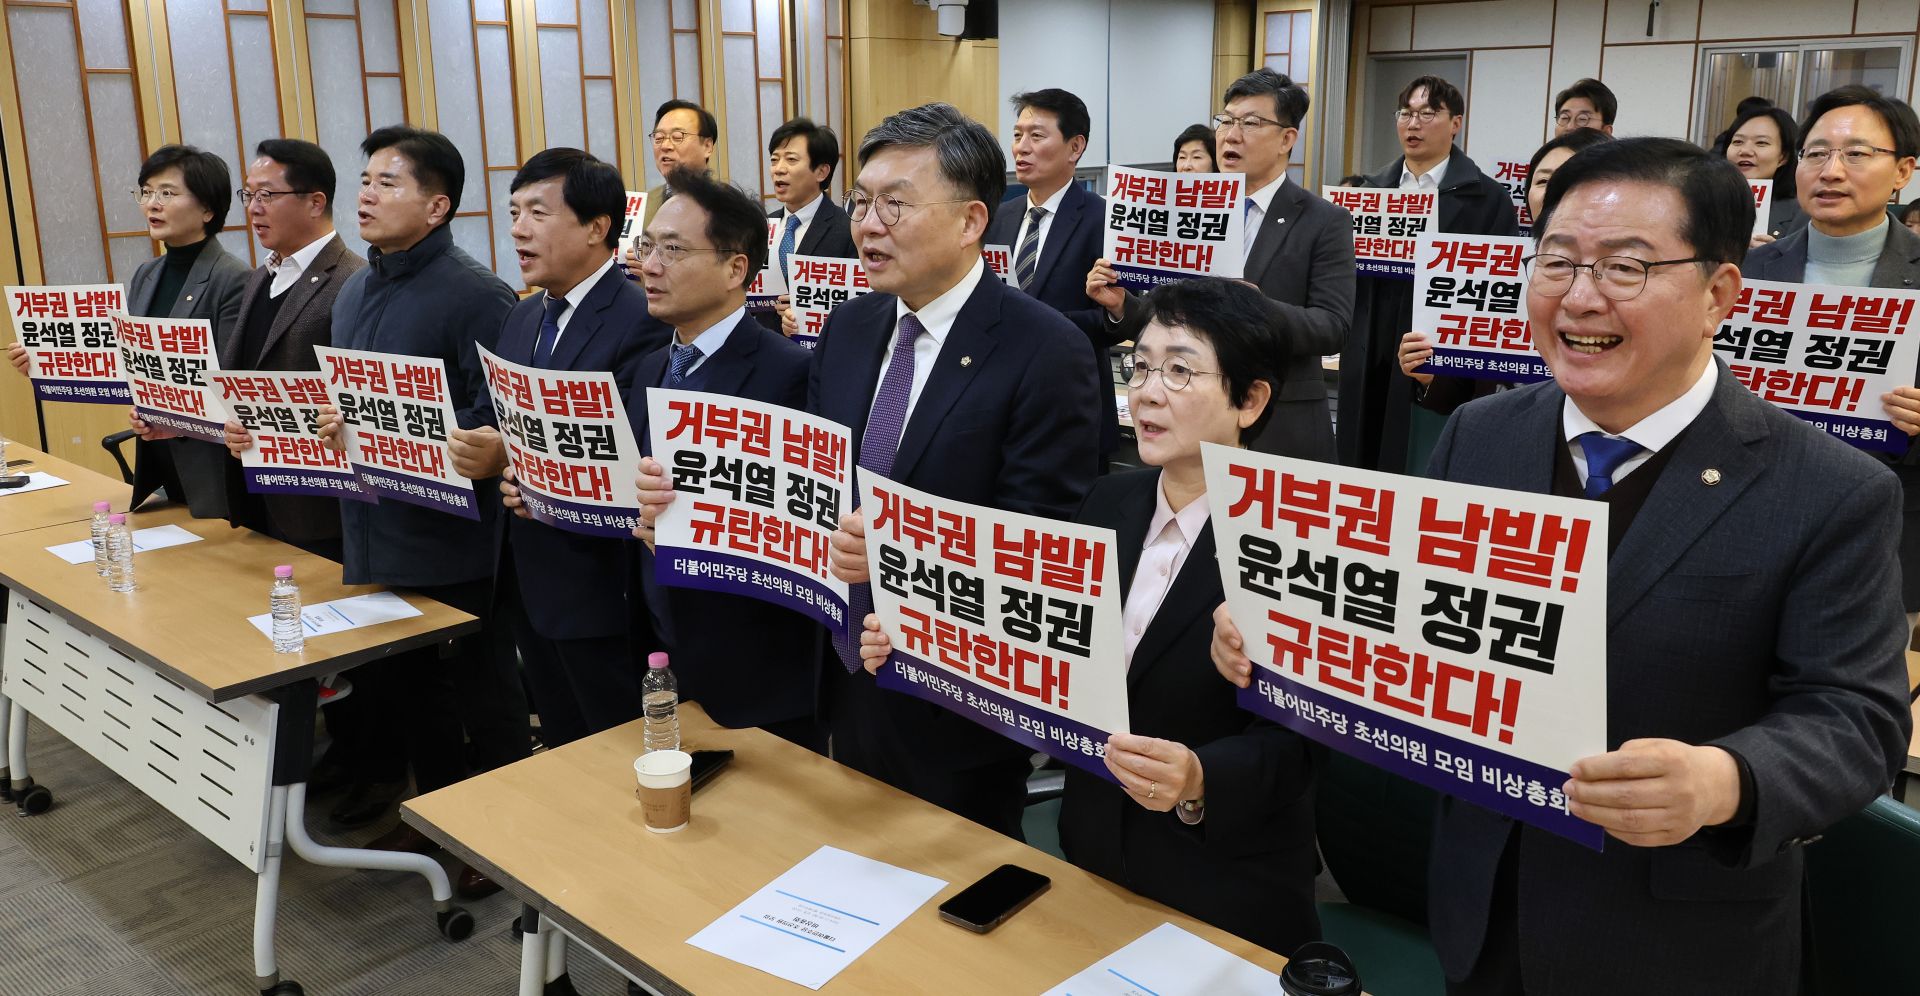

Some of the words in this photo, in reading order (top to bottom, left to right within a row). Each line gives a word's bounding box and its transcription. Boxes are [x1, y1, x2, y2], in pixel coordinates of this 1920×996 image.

[1112, 173, 1167, 205] 거부권
[1175, 180, 1239, 208] 남발!
[1495, 162, 1531, 182] 거부
[1110, 203, 1169, 236] 윤석열
[1177, 212, 1229, 241] 정권
[1329, 191, 1381, 212] 거부권
[1387, 193, 1434, 215] 남발!
[1352, 215, 1382, 235] 석열
[1388, 217, 1427, 237] 정권
[1115, 236, 1213, 272] 규탄한다!
[1354, 237, 1416, 260] 탄한다!
[1426, 241, 1524, 277] 거부권
[794, 260, 847, 286] 거부권
[1366, 263, 1390, 273] 초선의원
[1391, 265, 1403, 274] 모임
[15, 291, 69, 318] 거부권
[73, 290, 122, 317] 남발!
[1425, 276, 1522, 313] 윤석열
[1806, 294, 1916, 335] 남발!
[22, 322, 77, 347] 윤석열
[112, 315, 154, 350] 거부권
[157, 324, 208, 355] 남발!
[1712, 324, 1794, 364] 석열
[1804, 334, 1895, 375] 정권
[37, 351, 117, 378] 규탄한다!
[121, 346, 166, 381] 윤석열
[166, 357, 208, 386] 정권
[326, 355, 389, 394] 거부권
[391, 362, 444, 403] 남발!
[1487, 360, 1529, 375] 초선의원
[39, 384, 73, 395] 더불어민주당
[74, 386, 98, 397] 초선의원
[98, 387, 111, 398] 모임
[111, 388, 132, 398] 비상총
[134, 378, 207, 417] 규탄한다!
[213, 376, 284, 403] 거부권
[483, 355, 536, 412] 거부권
[538, 378, 615, 419] 남발!
[1729, 364, 1866, 412] 탄한다!
[233, 404, 301, 434] 윤석열
[337, 392, 401, 434] 윤석열
[401, 402, 448, 442] 정권
[494, 396, 549, 454] 윤석열
[552, 421, 619, 462] 정권
[1832, 424, 1888, 442] 비상총회
[357, 430, 446, 479] 규탄한다!
[666, 400, 772, 458] 거부권
[782, 418, 847, 484] 남발!
[255, 473, 299, 487] 더불어민주당
[300, 475, 329, 489] 초선의원
[328, 478, 343, 490] 모임
[361, 472, 399, 491] 더불어민주당
[400, 481, 427, 498] 초선의원
[426, 485, 441, 502] 모임
[440, 490, 469, 509] 비상총회
[509, 442, 613, 502] 규탄한다!
[671, 449, 776, 510] 윤석열
[786, 471, 841, 532] 정권
[546, 504, 581, 523] 초선의원
[581, 512, 603, 527] 모임
[1227, 463, 1396, 557] 거부권
[1417, 496, 1592, 594] 남발!
[690, 501, 830, 580] 규탄한다!
[872, 485, 977, 568] 거부권
[992, 522, 1107, 598] 남발!
[674, 557, 748, 584] 더불어민주당
[751, 570, 793, 597] 초선의원
[795, 583, 814, 606] 모임
[815, 592, 844, 627] 비상총회
[878, 543, 986, 627] 윤석열
[999, 584, 1095, 659] 정권
[1237, 533, 1400, 634] 윤석열
[1420, 577, 1565, 676] 정권
[899, 604, 1071, 711] 규탄한다!
[1266, 608, 1522, 746] 규탄한다!
[894, 661, 963, 703] 더불어민주당
[966, 691, 1016, 728] 초선의원
[1018, 713, 1046, 740] 모임
[1257, 678, 1349, 736] 더불어민주당
[1353, 721, 1428, 766] 초선의원
[1434, 751, 1474, 782] 모임
[1481, 765, 1571, 816] 비상총회
